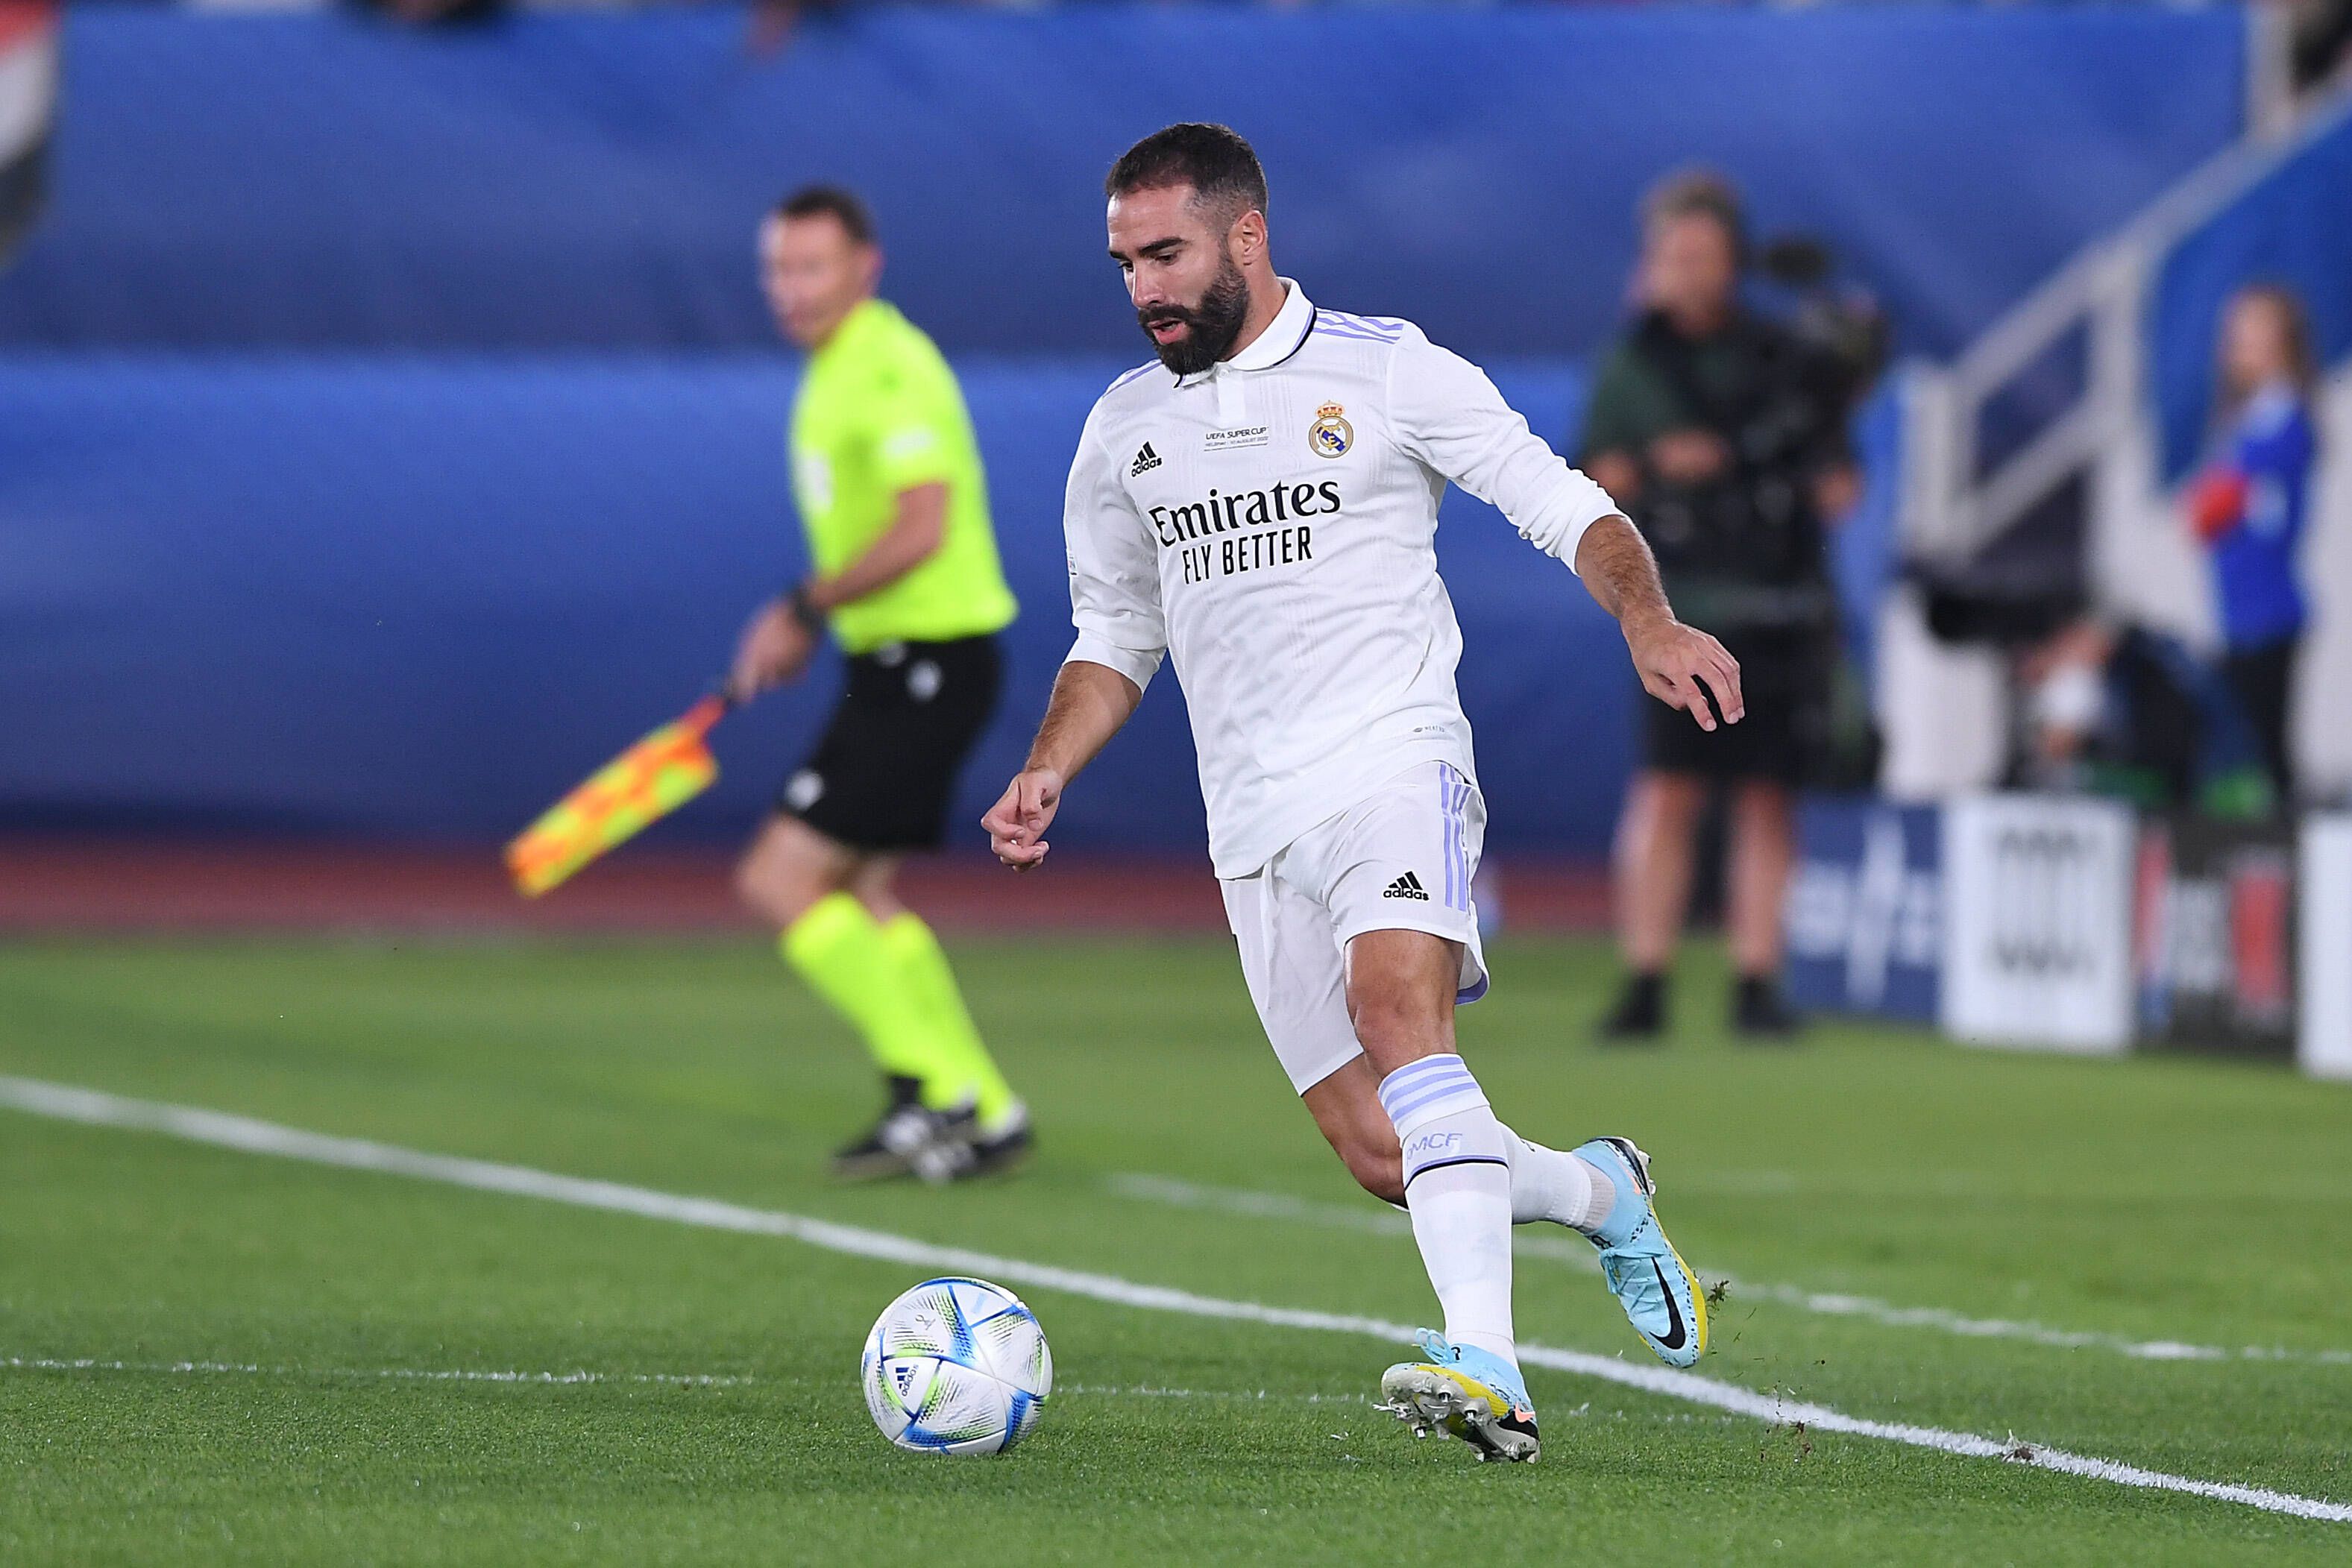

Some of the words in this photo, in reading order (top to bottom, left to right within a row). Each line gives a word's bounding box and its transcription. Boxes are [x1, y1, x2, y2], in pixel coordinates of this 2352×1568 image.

[1206, 432, 1225, 440] UEFA
[1227, 429, 1251, 439] SUPER
[1251, 426, 1267, 435] CUP
[1131, 457, 1163, 478] adidas
[1148, 480, 1341, 547] Emirates
[1182, 544, 1212, 585] FLY
[1222, 526, 1313, 576] BETTER
[1383, 887, 1430, 901] adidas
[901, 1364, 919, 1397] adidas
